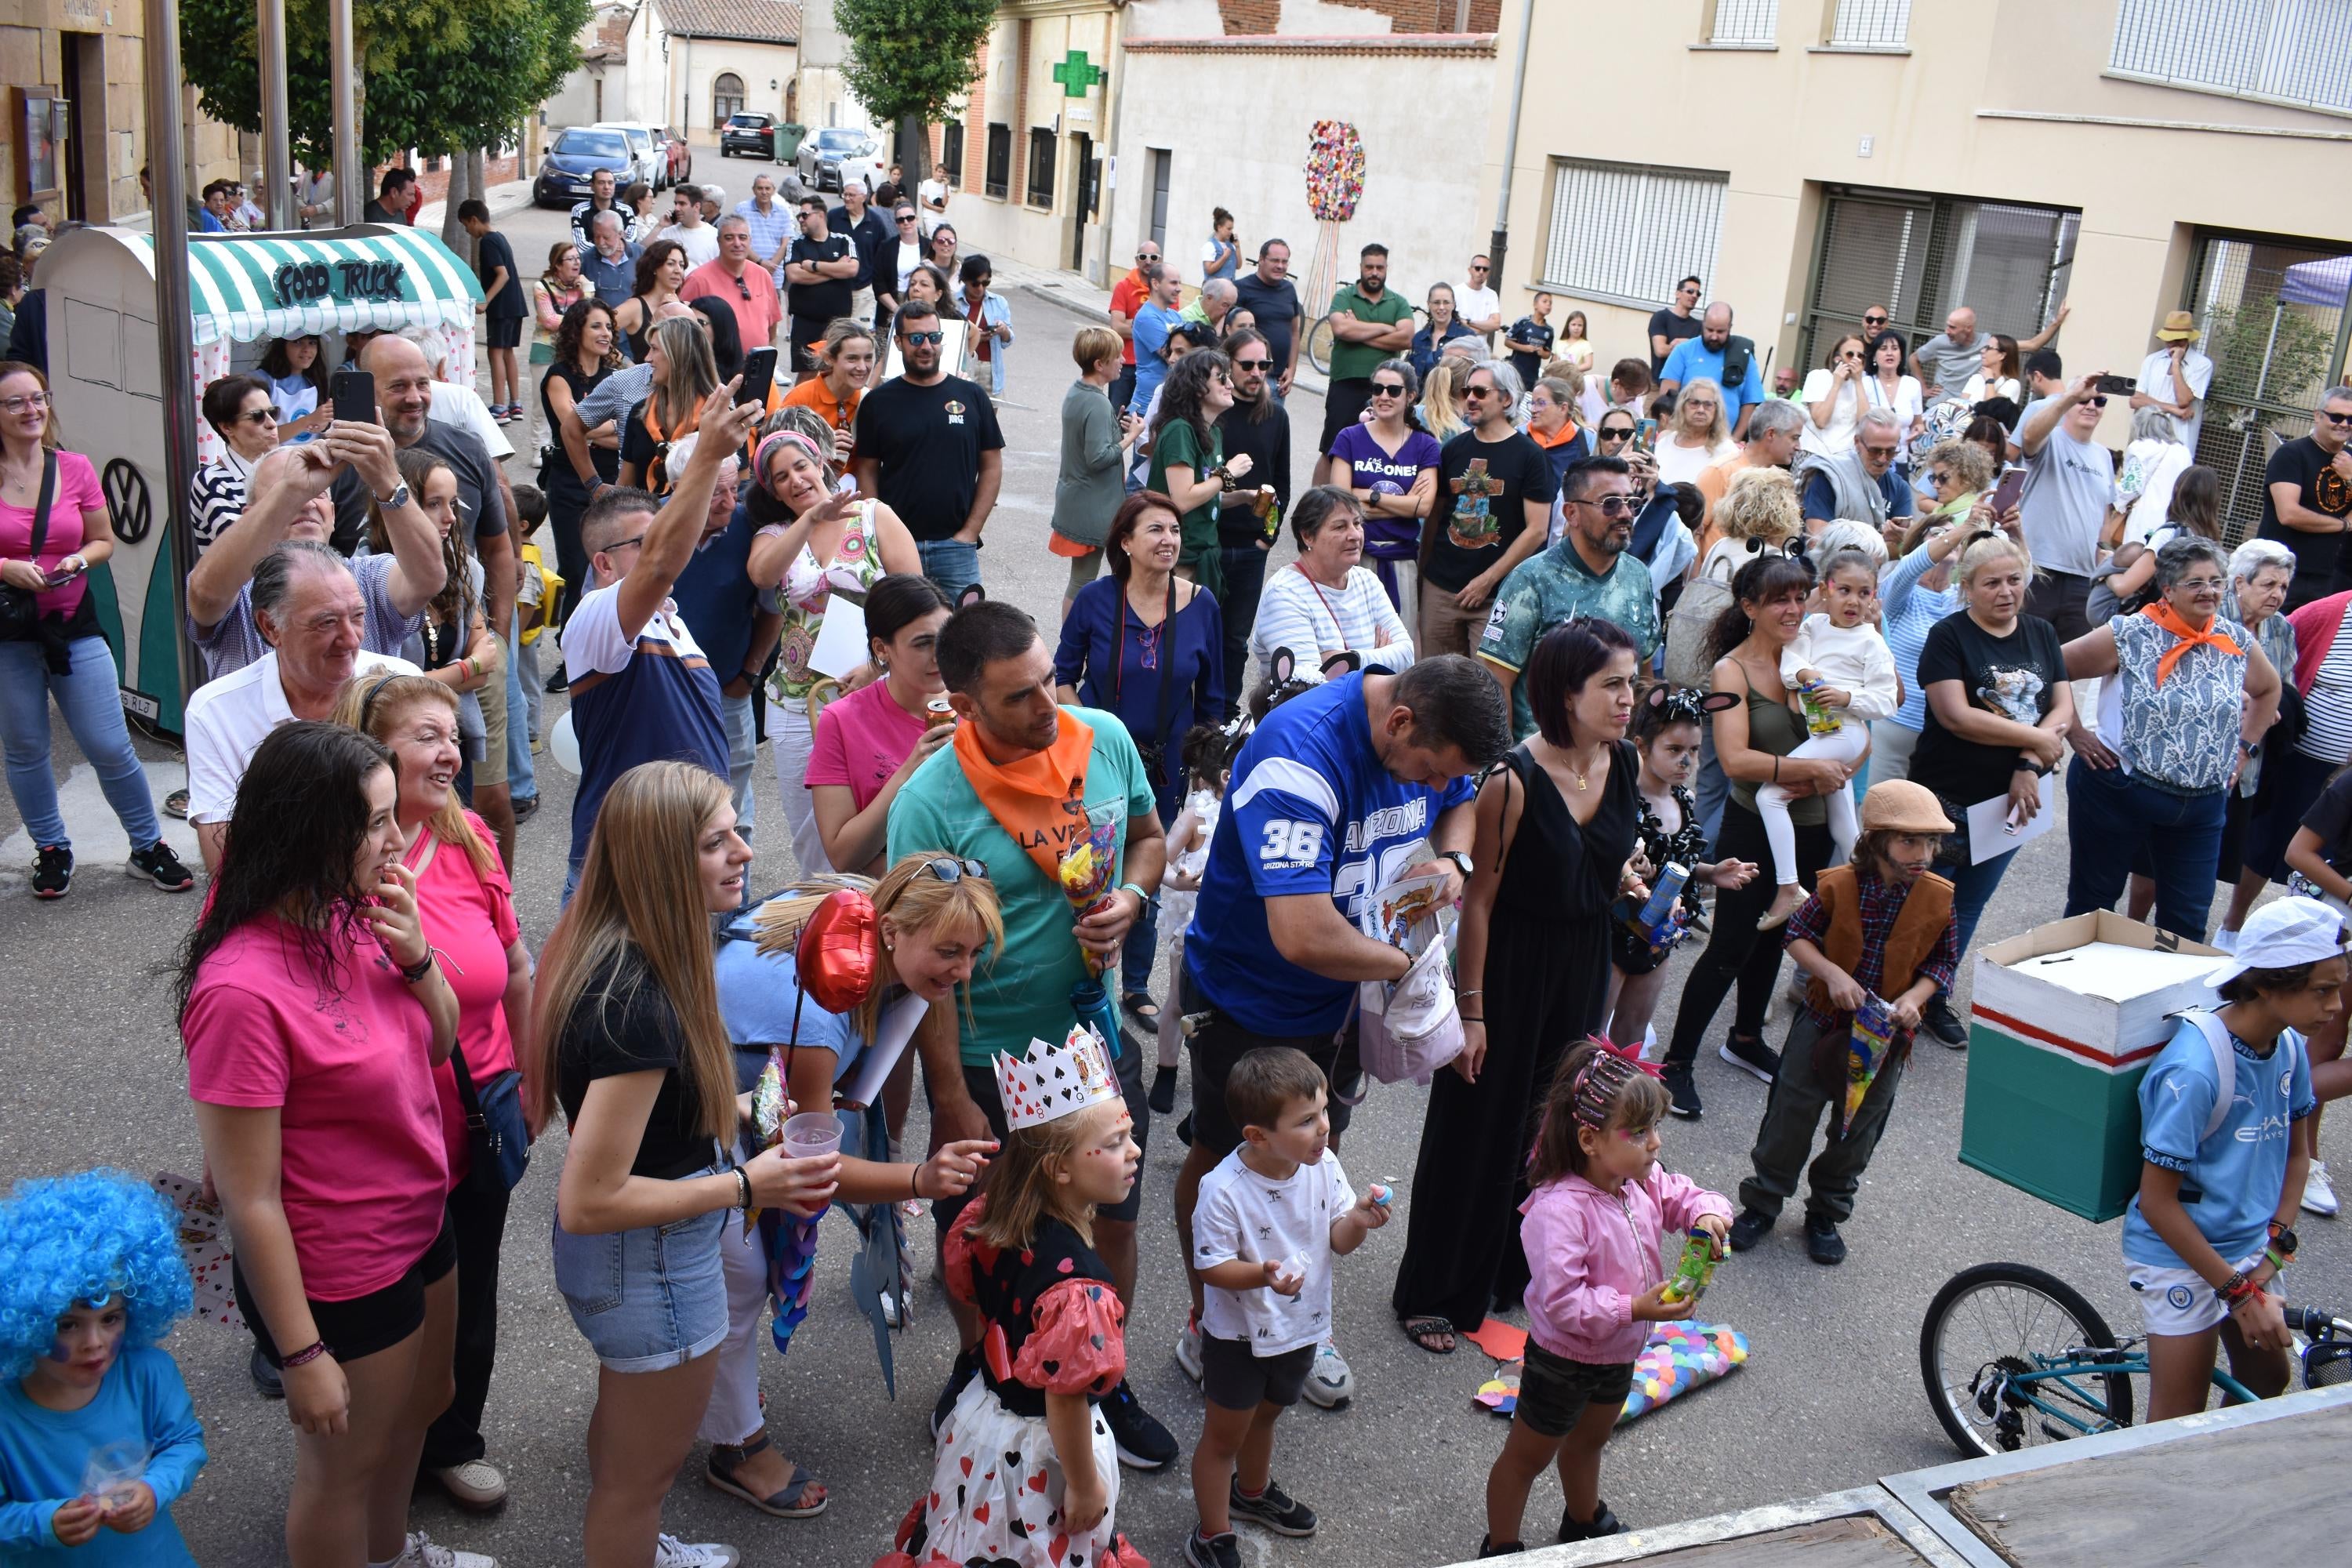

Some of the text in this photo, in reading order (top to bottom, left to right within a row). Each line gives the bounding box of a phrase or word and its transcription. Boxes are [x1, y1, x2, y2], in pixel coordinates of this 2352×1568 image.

[278, 262, 403, 305] FOOD TRUCK
[948, 414, 964, 424] JORGE
[132, 696, 151, 713] RLJ
[1019, 829, 1049, 849] LA
[1260, 819, 1323, 861] 36
[1263, 858, 1315, 870] ARIZONA STARS
[1036, 1108, 1045, 1120] 8
